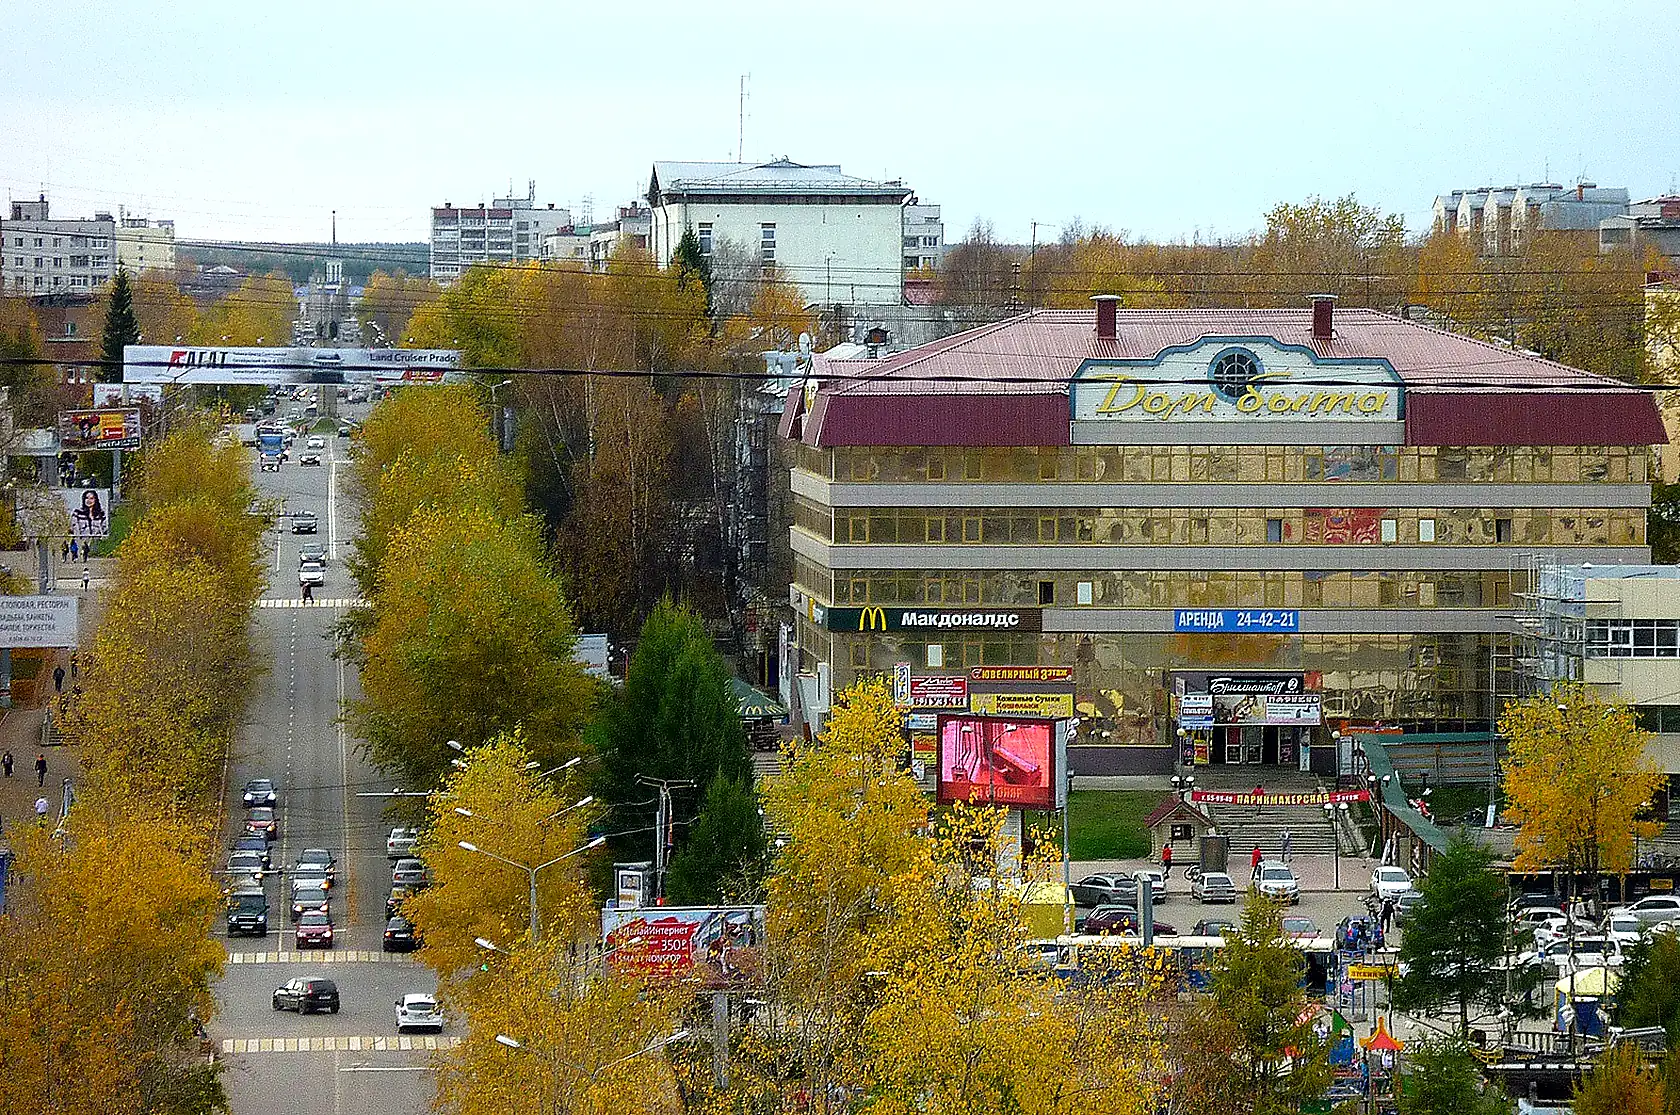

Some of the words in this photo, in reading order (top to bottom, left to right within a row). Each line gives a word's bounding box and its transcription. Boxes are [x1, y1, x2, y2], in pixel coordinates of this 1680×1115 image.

[369, 353, 392, 363] Land
[394, 353, 427, 363] Cruiser
[429, 353, 456, 363] Prado
[1088, 373, 1217, 420] Дом
[1236, 372, 1390, 414] быта
[901, 612, 1019, 628] Макдоналдс
[1179, 612, 1224, 629] АРЕНДА
[1237, 612, 1295, 627] 24-42-21
[982, 668, 1039, 680] ЮВЕЛИРНЫЙ
[1236, 793, 1330, 805] ПАРИКМАХЕРСКАЯ
[661, 939, 681, 951] 350
